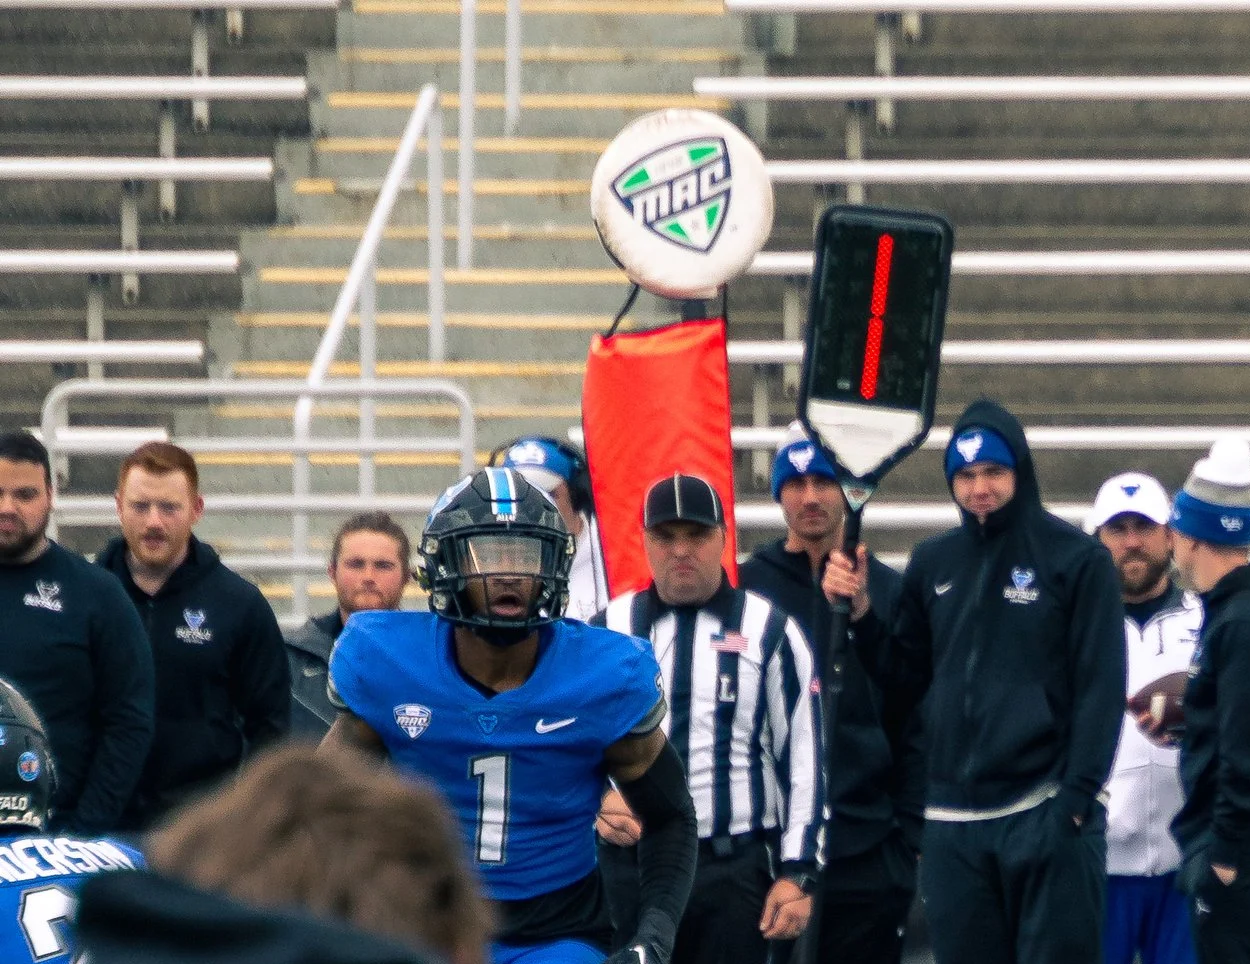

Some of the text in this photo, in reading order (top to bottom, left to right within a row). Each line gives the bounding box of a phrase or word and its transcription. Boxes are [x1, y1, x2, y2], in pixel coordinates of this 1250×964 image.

[631, 160, 732, 224] MAC
[718, 675, 735, 702] L
[467, 752, 511, 865] 1
